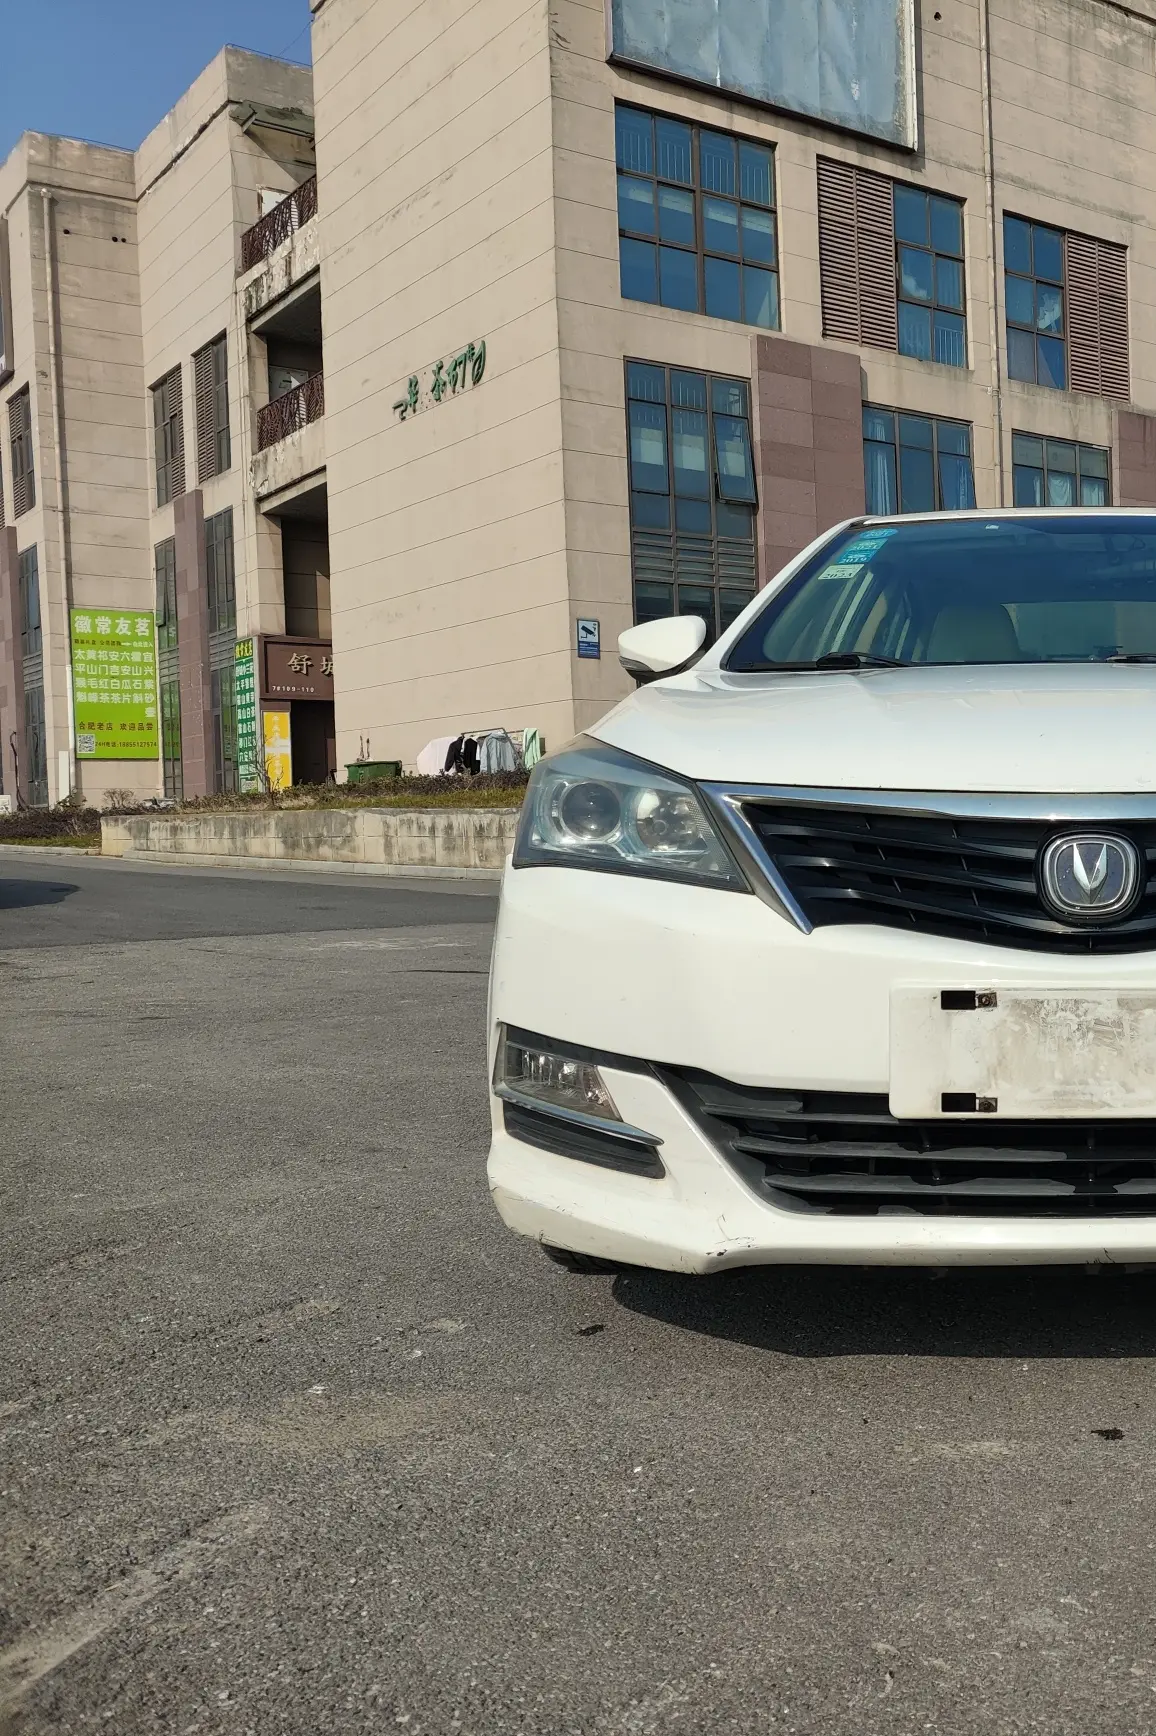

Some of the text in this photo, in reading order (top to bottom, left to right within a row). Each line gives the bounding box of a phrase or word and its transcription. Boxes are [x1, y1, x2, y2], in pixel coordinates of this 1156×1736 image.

[74, 615, 151, 636] 徽常友茗
[119, 722, 154, 731] 欢迎品尝
